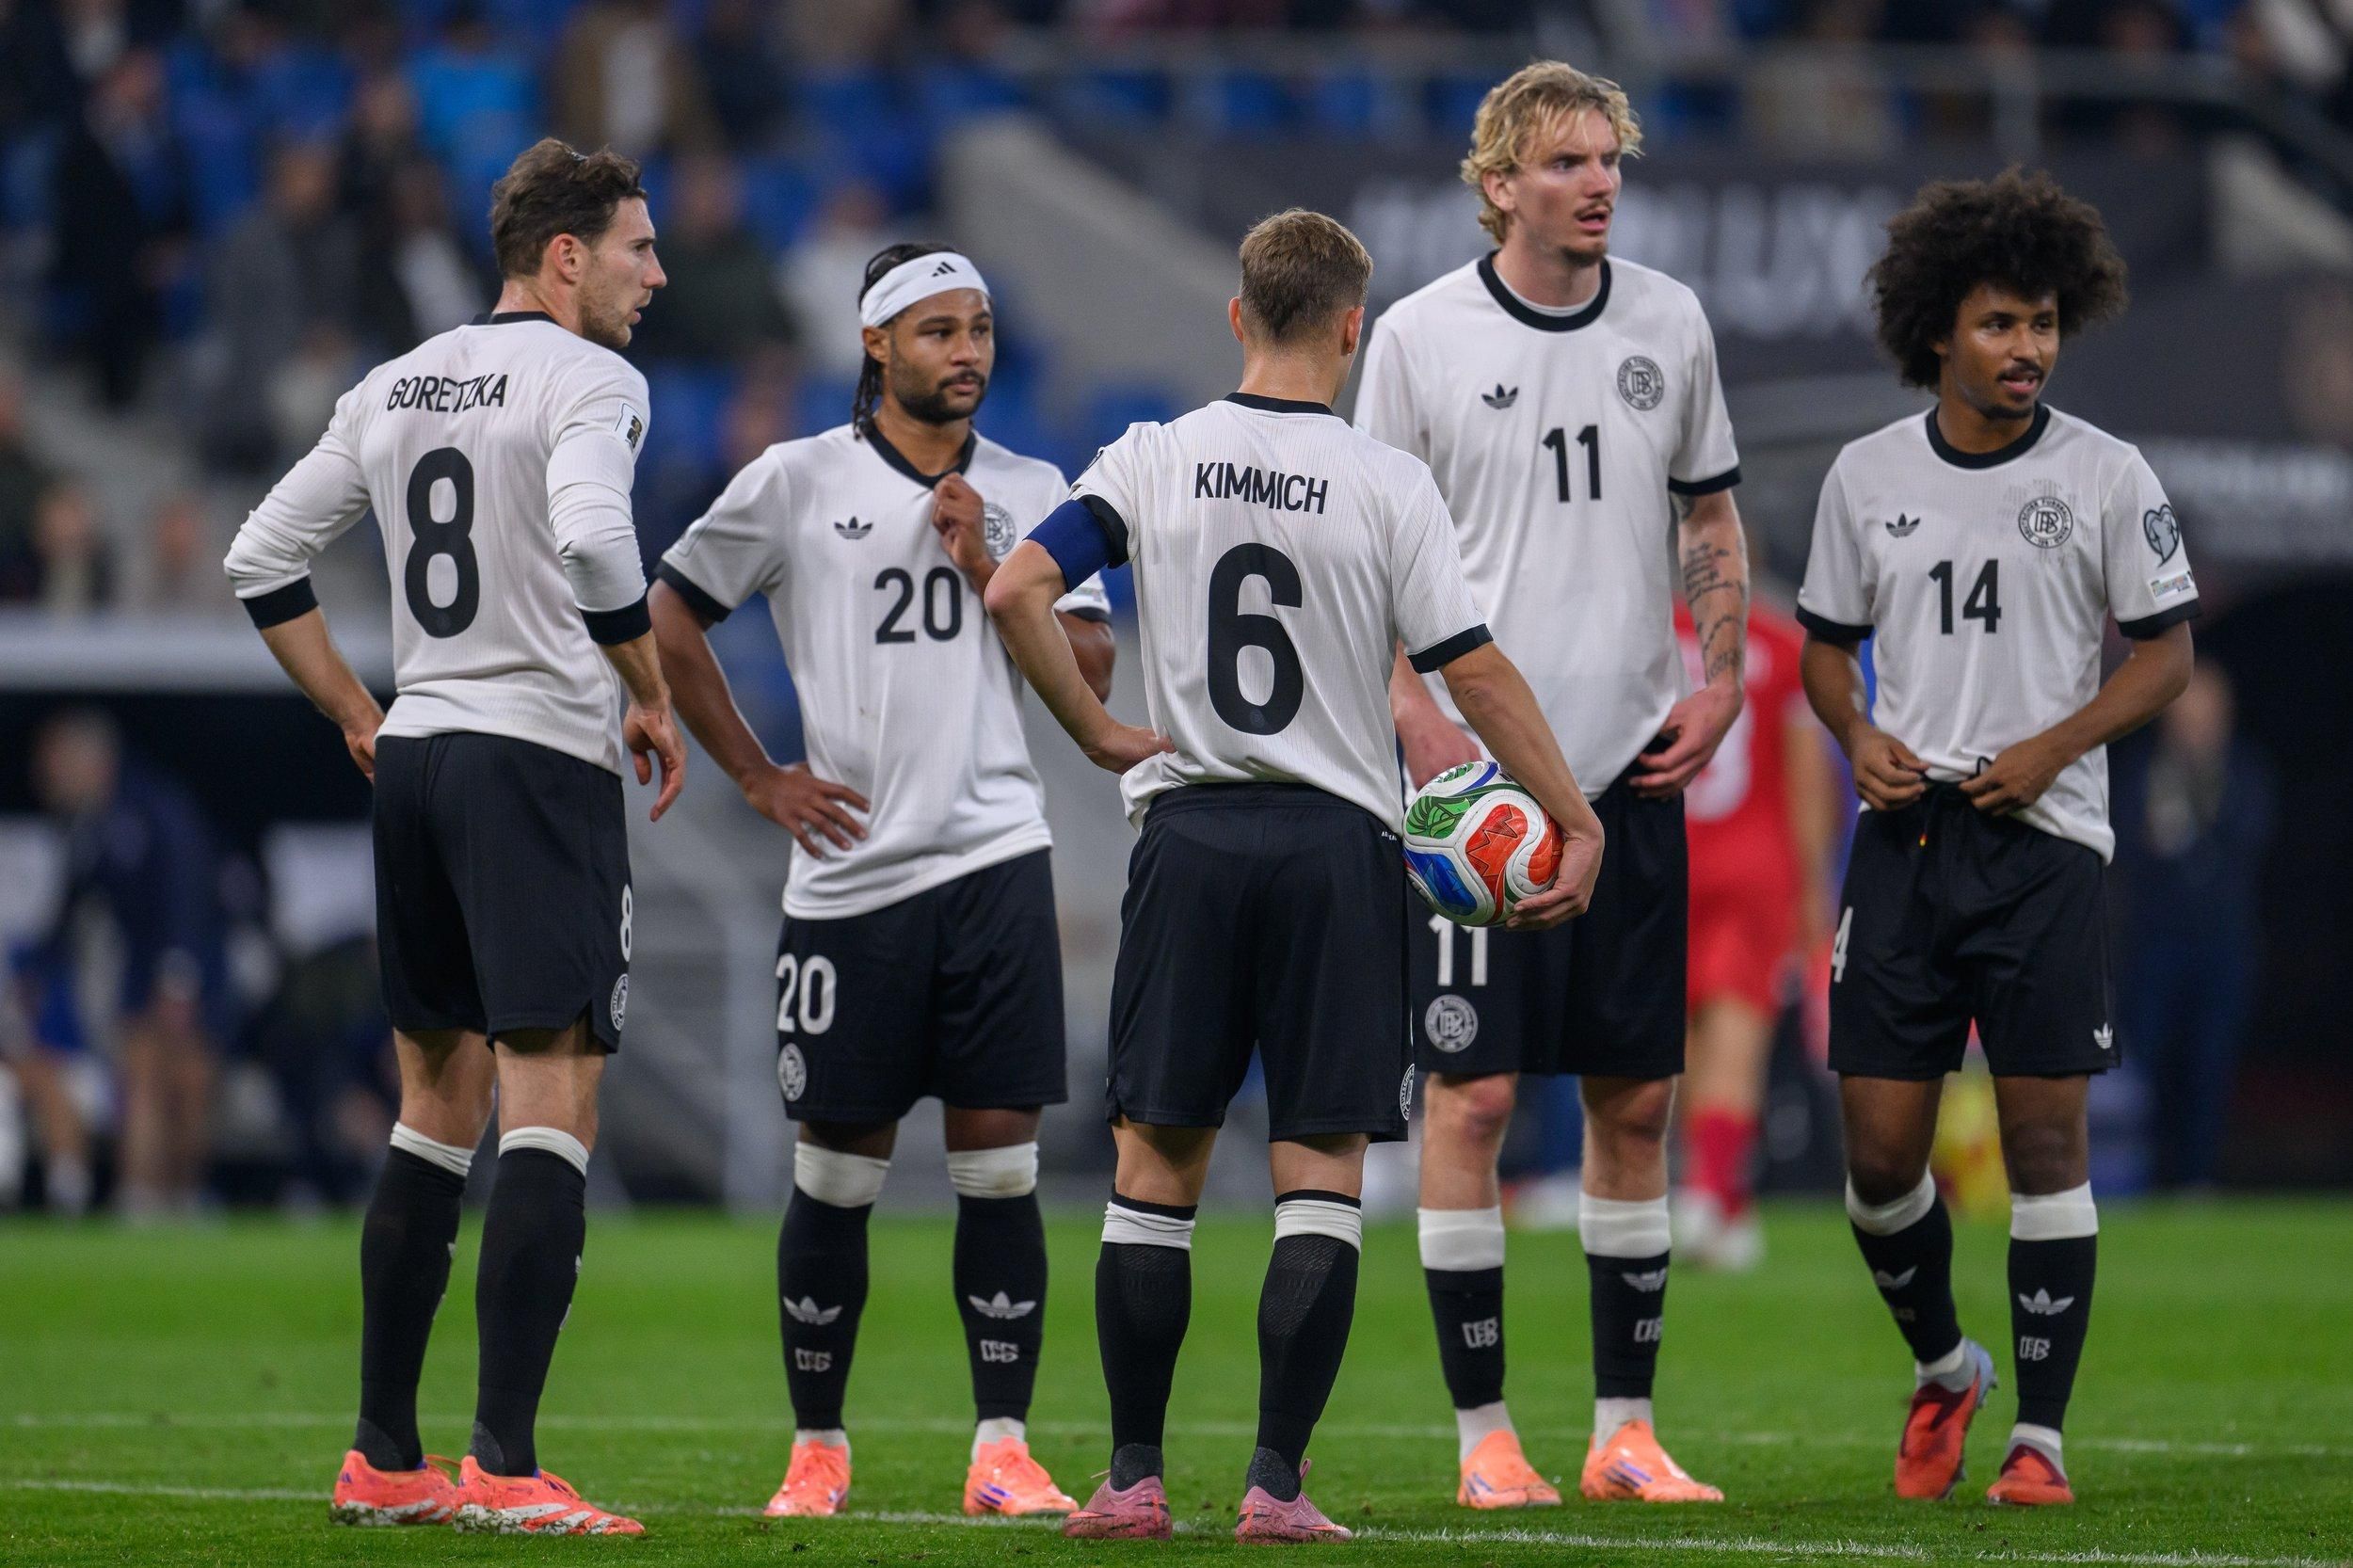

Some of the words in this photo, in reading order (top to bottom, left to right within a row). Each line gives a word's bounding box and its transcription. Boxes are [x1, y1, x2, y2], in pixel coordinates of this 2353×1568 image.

[387, 374, 509, 413] GORETZKA
[1193, 461, 1329, 515] KIMMICH
[1542, 424, 1602, 504] 11
[404, 446, 481, 639] 8
[872, 566, 963, 645] 20
[1928, 557, 2002, 635] 14
[1206, 541, 1305, 736] 6
[619, 883, 633, 963] 8
[1427, 912, 1489, 987] 11
[775, 952, 838, 1035] 20
